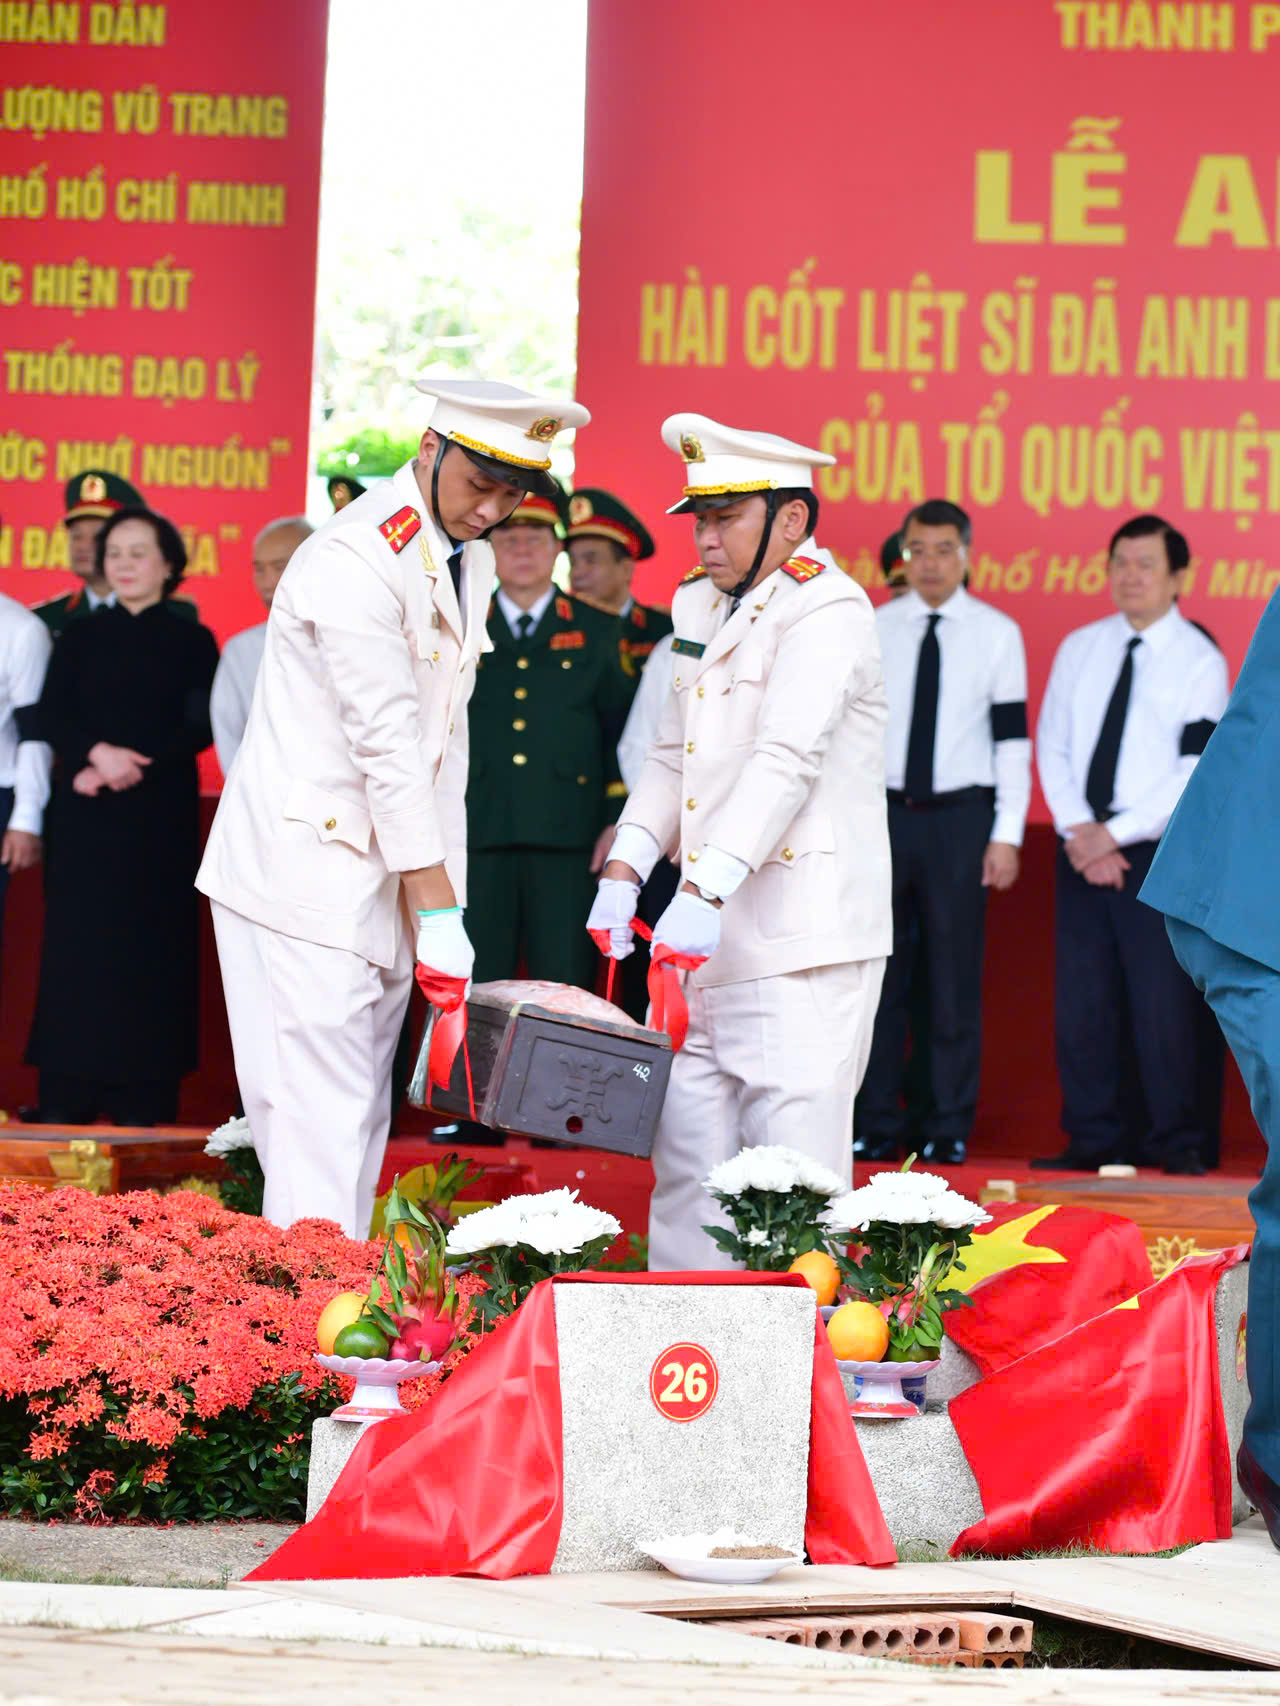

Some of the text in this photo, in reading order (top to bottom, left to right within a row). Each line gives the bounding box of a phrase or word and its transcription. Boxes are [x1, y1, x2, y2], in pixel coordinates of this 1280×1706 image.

[0, 84, 288, 140] ƯỢNG VŨ TRANG
[0, 163, 47, 219] HỐ
[115, 172, 178, 223] CHÍ
[186, 181, 285, 227] MINH
[972, 116, 1128, 246] LỄ
[31, 256, 119, 317] HIỆN
[127, 254, 193, 312] TỐT
[639, 266, 729, 368] HÀI
[743, 256, 845, 371] CỐT
[858, 272, 967, 392] LIỆT
[979, 275, 1038, 377] SĨ
[1048, 276, 1121, 377] ĐÃ
[1135, 294, 1250, 380] ANH
[4, 338, 260, 409] THỐNG ĐẠO LÝ
[0, 429, 46, 482] ỚC
[819, 391, 926, 505] CỦA
[938, 388, 1010, 508] TỔ
[1020, 396, 1164, 518] QUỐC
[632, 1063, 651, 1083] 42
[660, 1362, 708, 1402] 26
